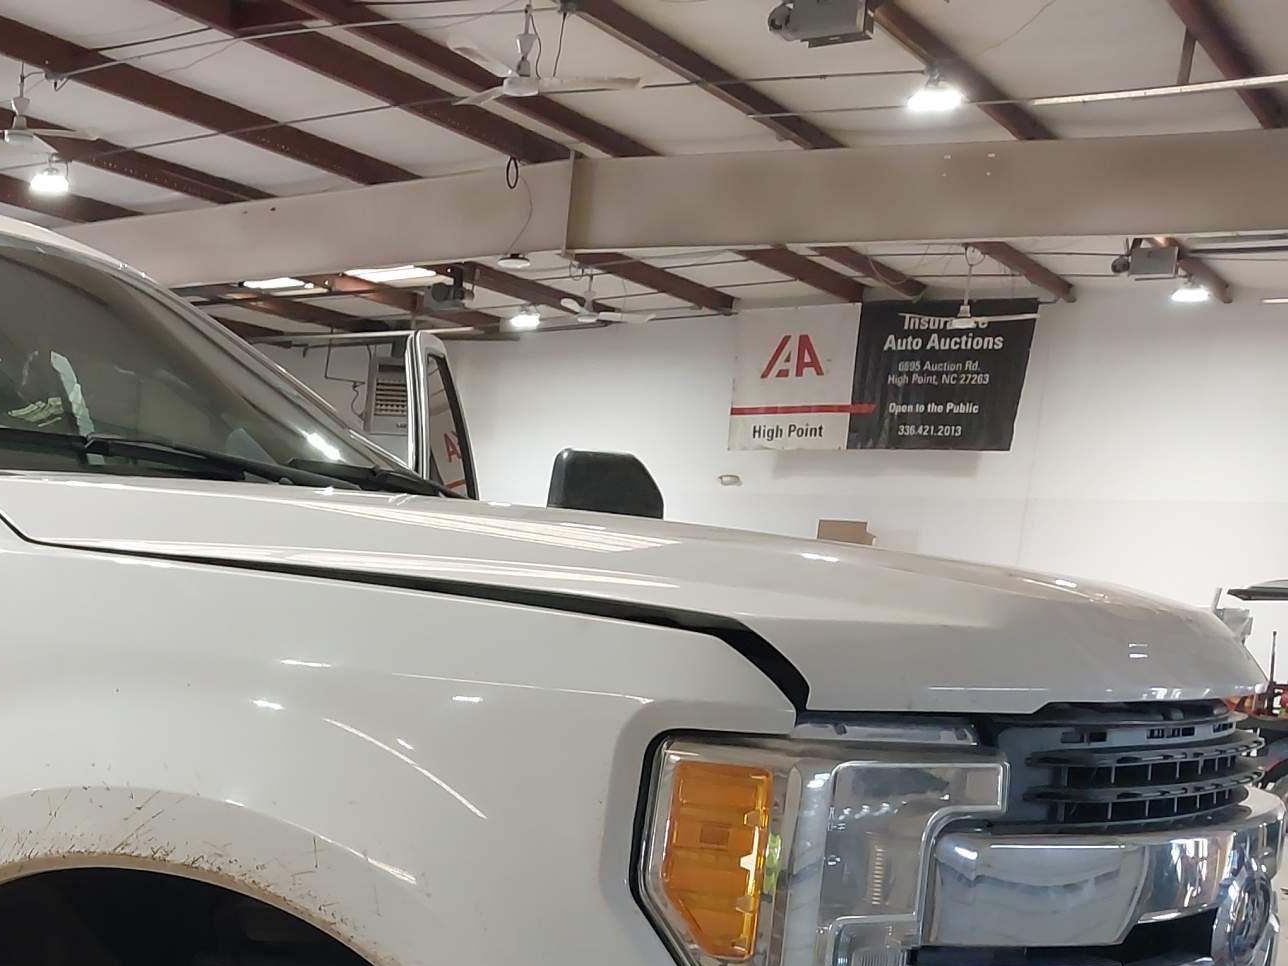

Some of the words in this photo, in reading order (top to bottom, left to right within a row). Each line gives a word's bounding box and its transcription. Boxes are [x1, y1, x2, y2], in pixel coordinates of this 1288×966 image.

[904, 314, 988, 330] Insurae
[883, 334, 922, 351] Auto
[926, 333, 1004, 351] Auctions
[923, 361, 962, 371] Auction
[965, 361, 981, 371] Rd.
[888, 375, 909, 387] High
[912, 374, 939, 385] Point,
[942, 374, 957, 384] NC
[960, 374, 990, 384] 27263
[889, 403, 913, 415] Open
[916, 404, 925, 413] to
[927, 403, 944, 413] the
[946, 403, 979, 413] Public
[752, 424, 783, 441] High
[788, 423, 824, 438] Point
[898, 425, 962, 436] 336.421.2013
